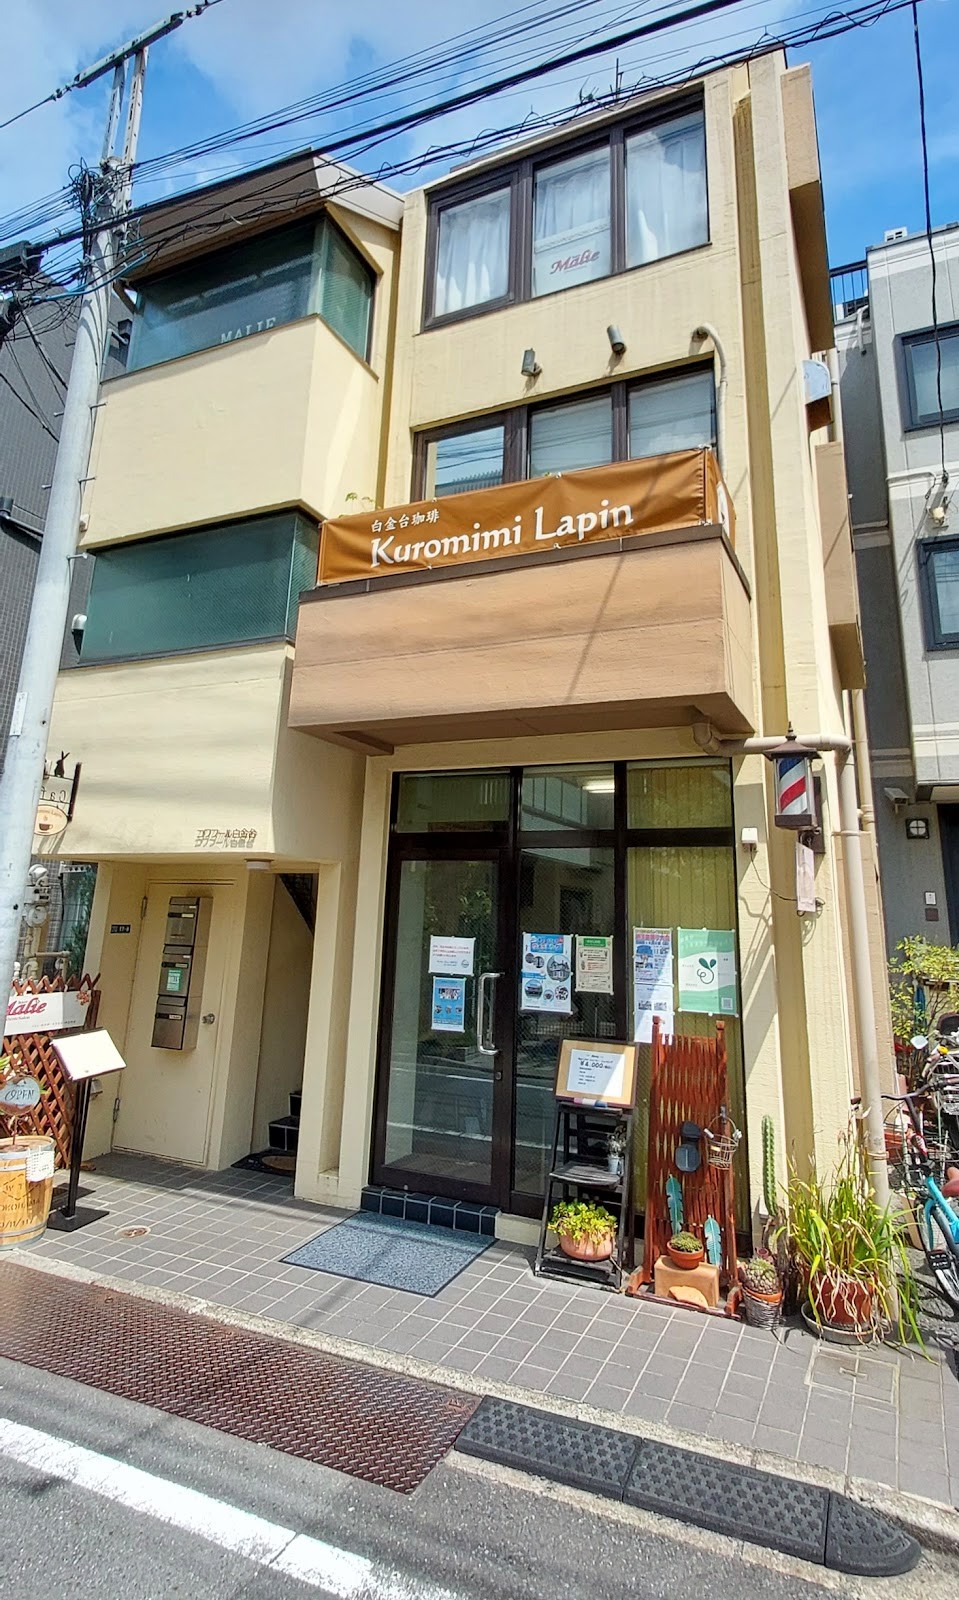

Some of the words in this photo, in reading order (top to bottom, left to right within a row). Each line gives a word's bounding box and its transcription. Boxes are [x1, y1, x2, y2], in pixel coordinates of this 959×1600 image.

[371, 508, 440, 533] 白金台珈琲
[370, 515, 522, 568] Kuromimi
[534, 499, 634, 541] Lapin
[4, 1089, 35, 1102] OPEN
